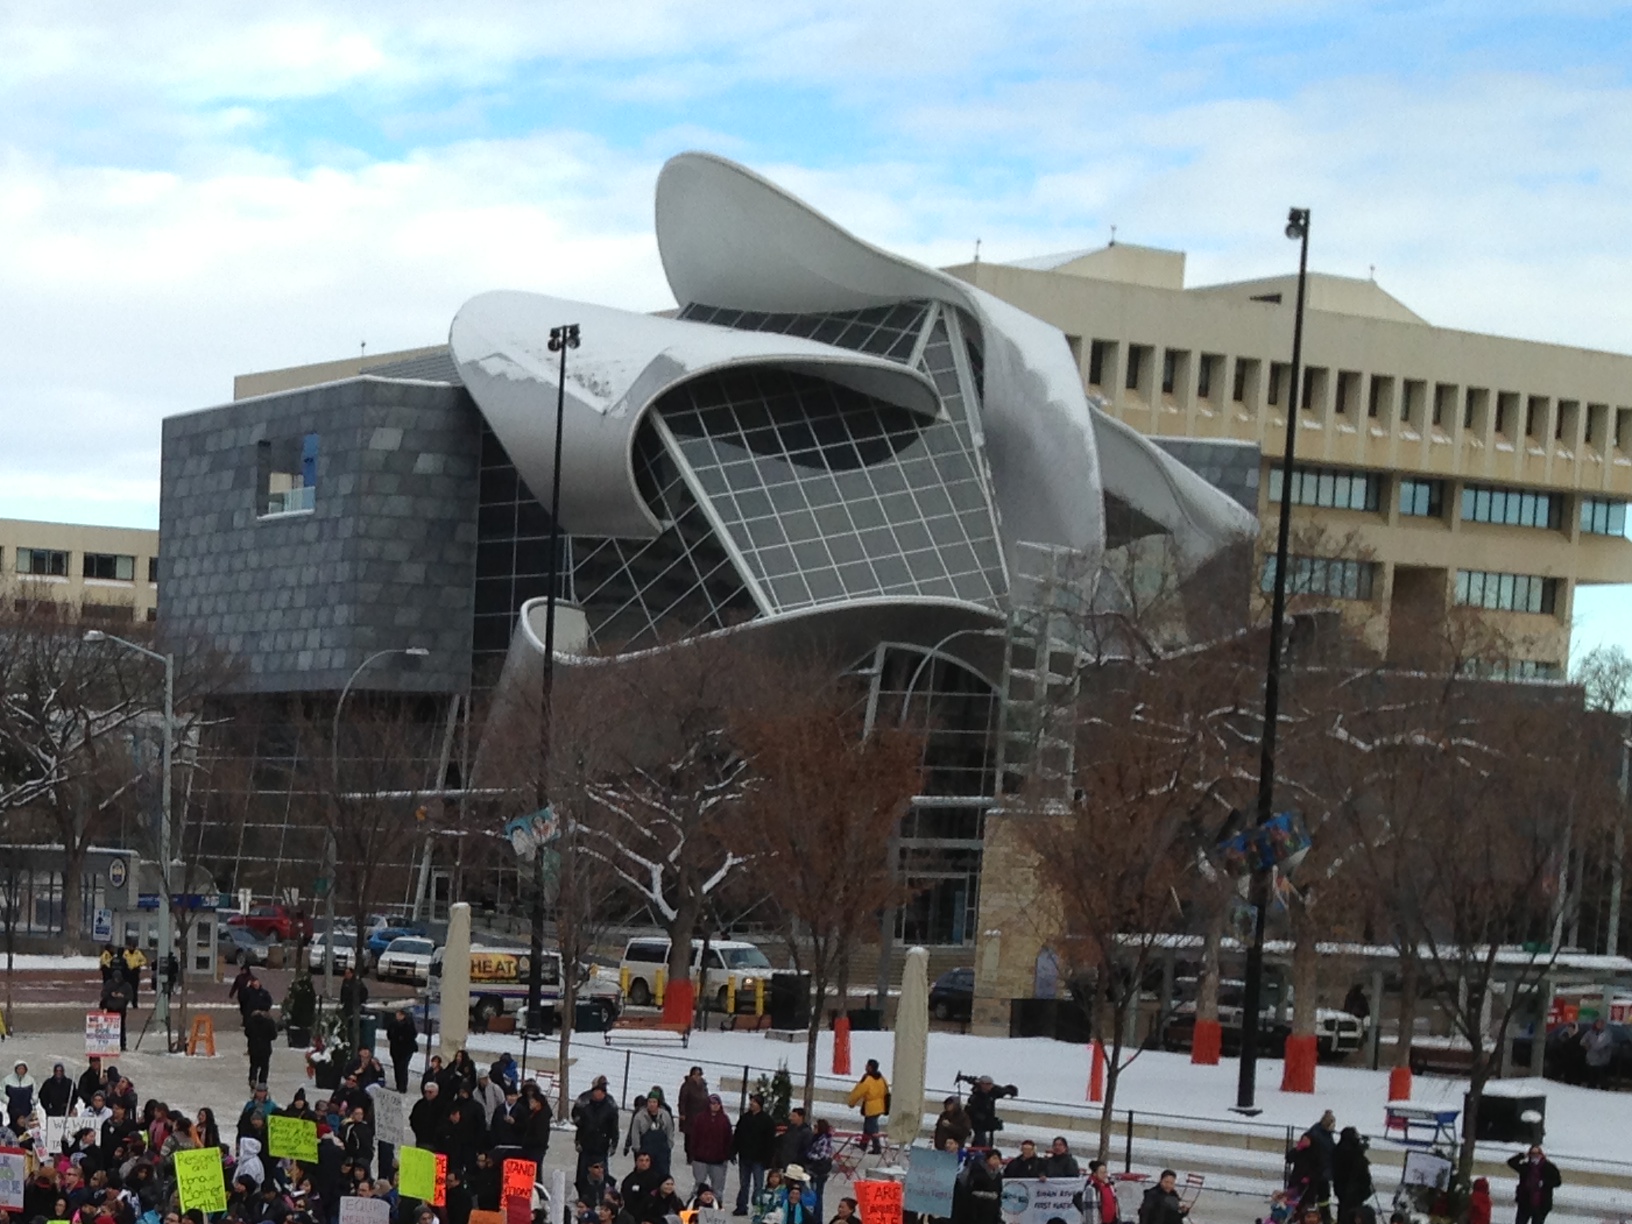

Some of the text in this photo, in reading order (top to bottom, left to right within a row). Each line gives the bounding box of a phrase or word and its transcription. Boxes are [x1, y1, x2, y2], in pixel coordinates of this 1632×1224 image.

[471, 959, 514, 974] HEAT
[178, 1153, 220, 1166] Respect
[192, 1164, 208, 1172] and
[506, 1161, 535, 1176] STAND
[182, 1185, 222, 1199] Mother
[874, 1186, 901, 1201] ARE
